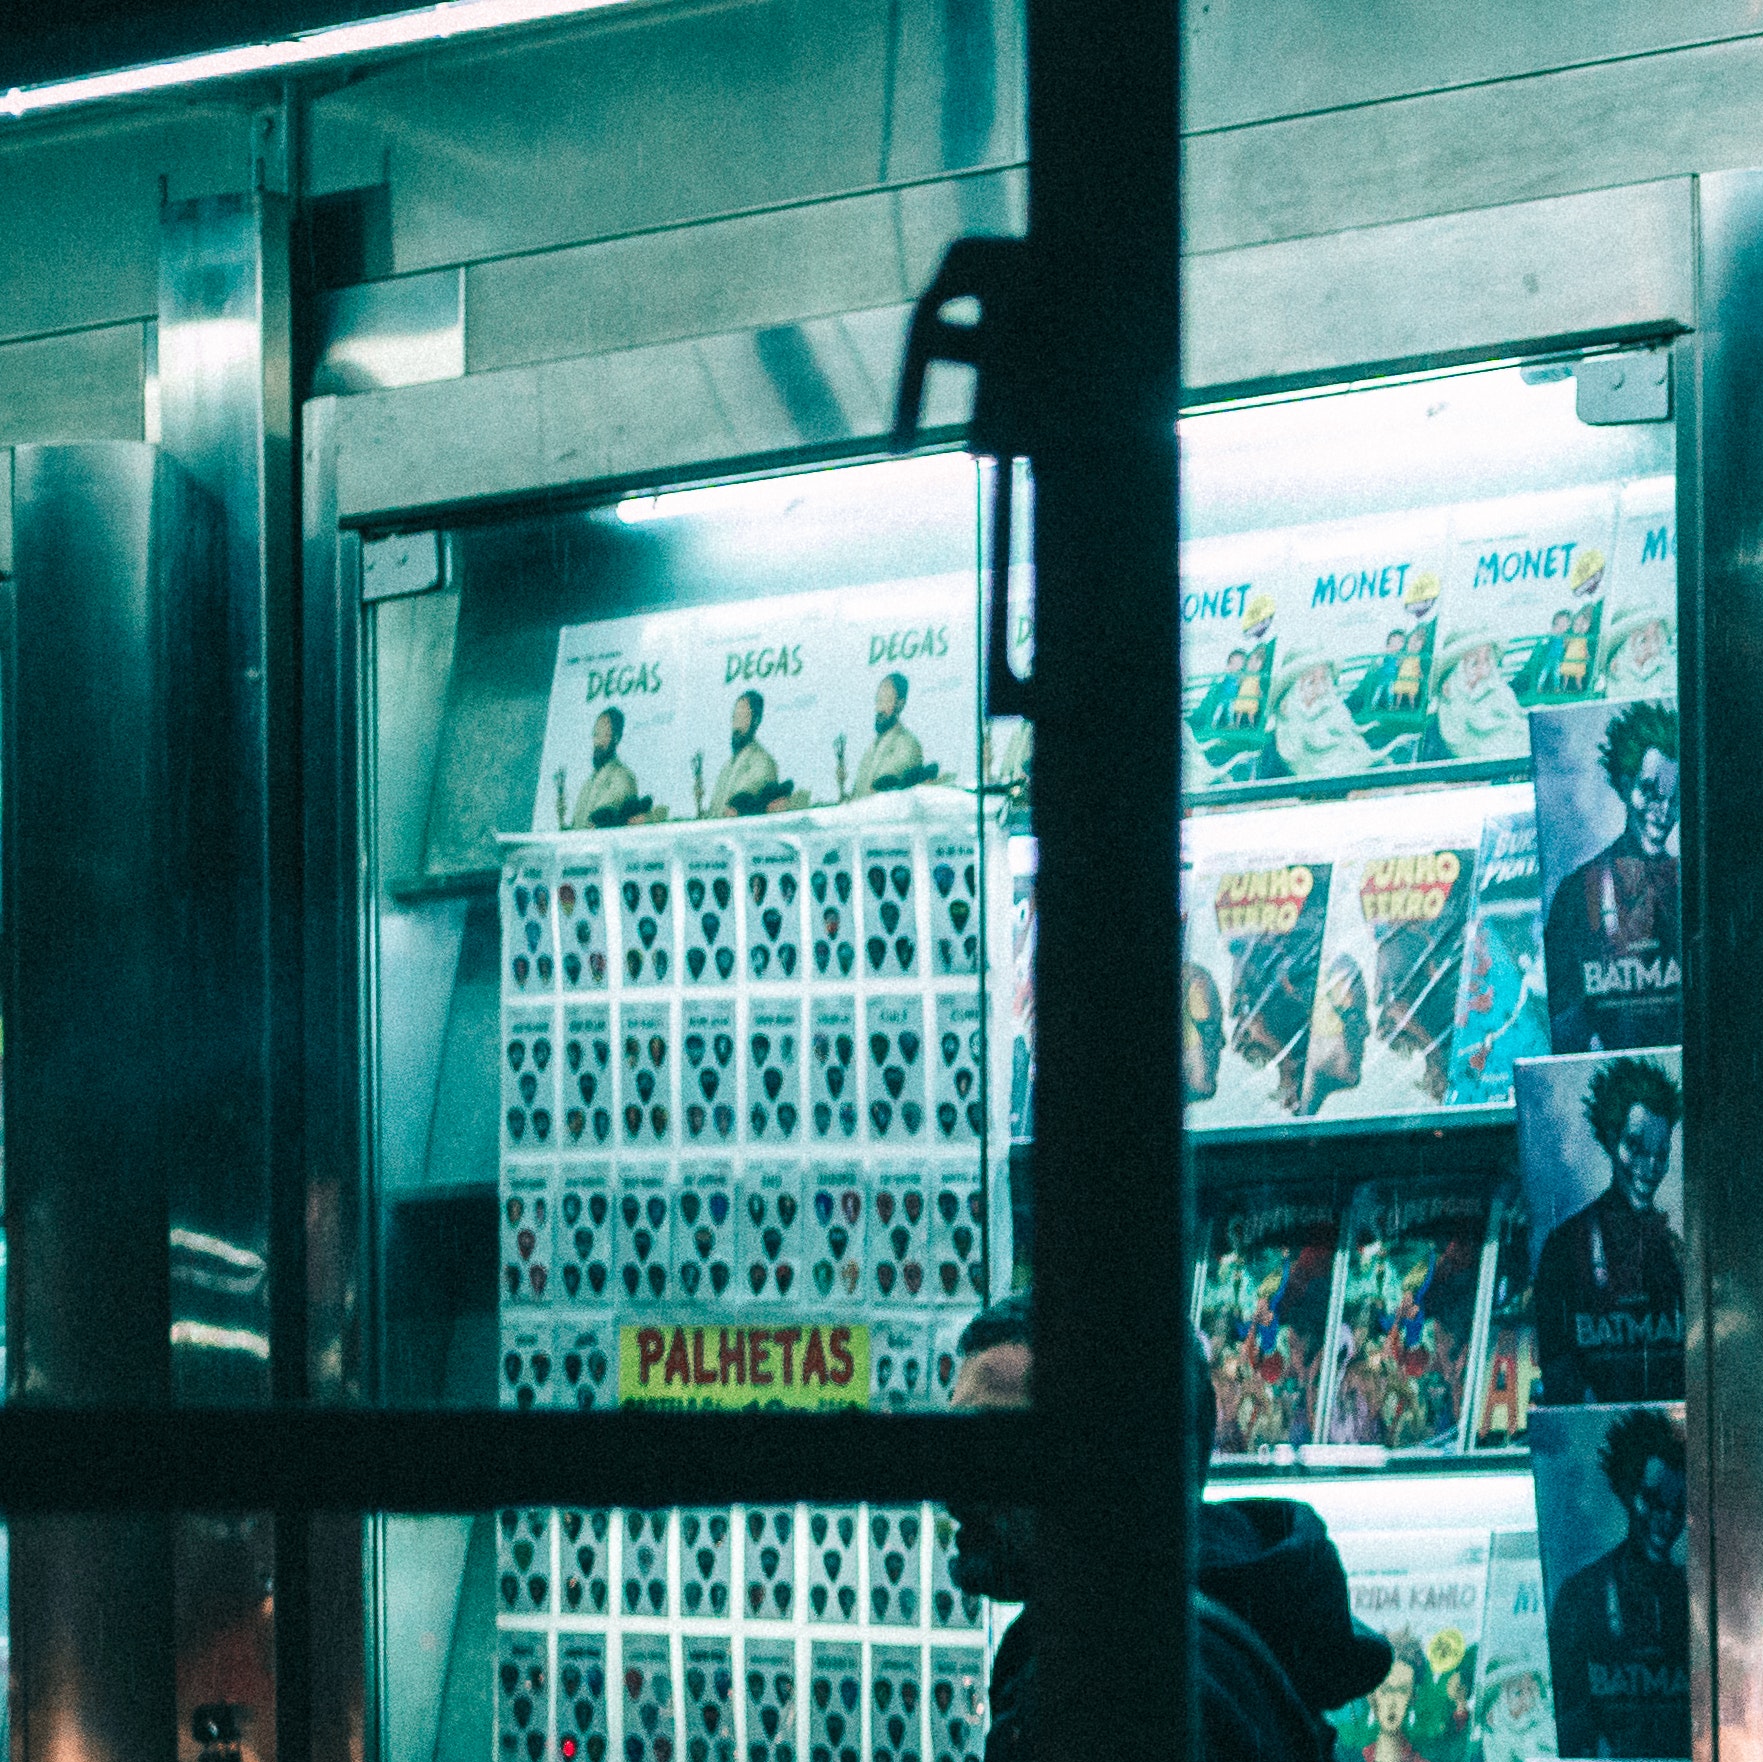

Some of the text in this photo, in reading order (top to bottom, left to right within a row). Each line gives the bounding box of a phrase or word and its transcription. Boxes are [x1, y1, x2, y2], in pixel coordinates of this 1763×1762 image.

[1311, 562, 1410, 609] MONET
[1474, 542, 1578, 589] MONET
[1183, 583, 1252, 622] ONET
[724, 643, 804, 684] DEGAS
[869, 625, 949, 666] DEGAS
[586, 661, 662, 701] DEGAS
[1582, 956, 1682, 995] BATMA
[637, 1326, 854, 1387] PALHETAS
[1352, 1583, 1401, 1612] RIDA
[1587, 1661, 1687, 1697] BATMA
